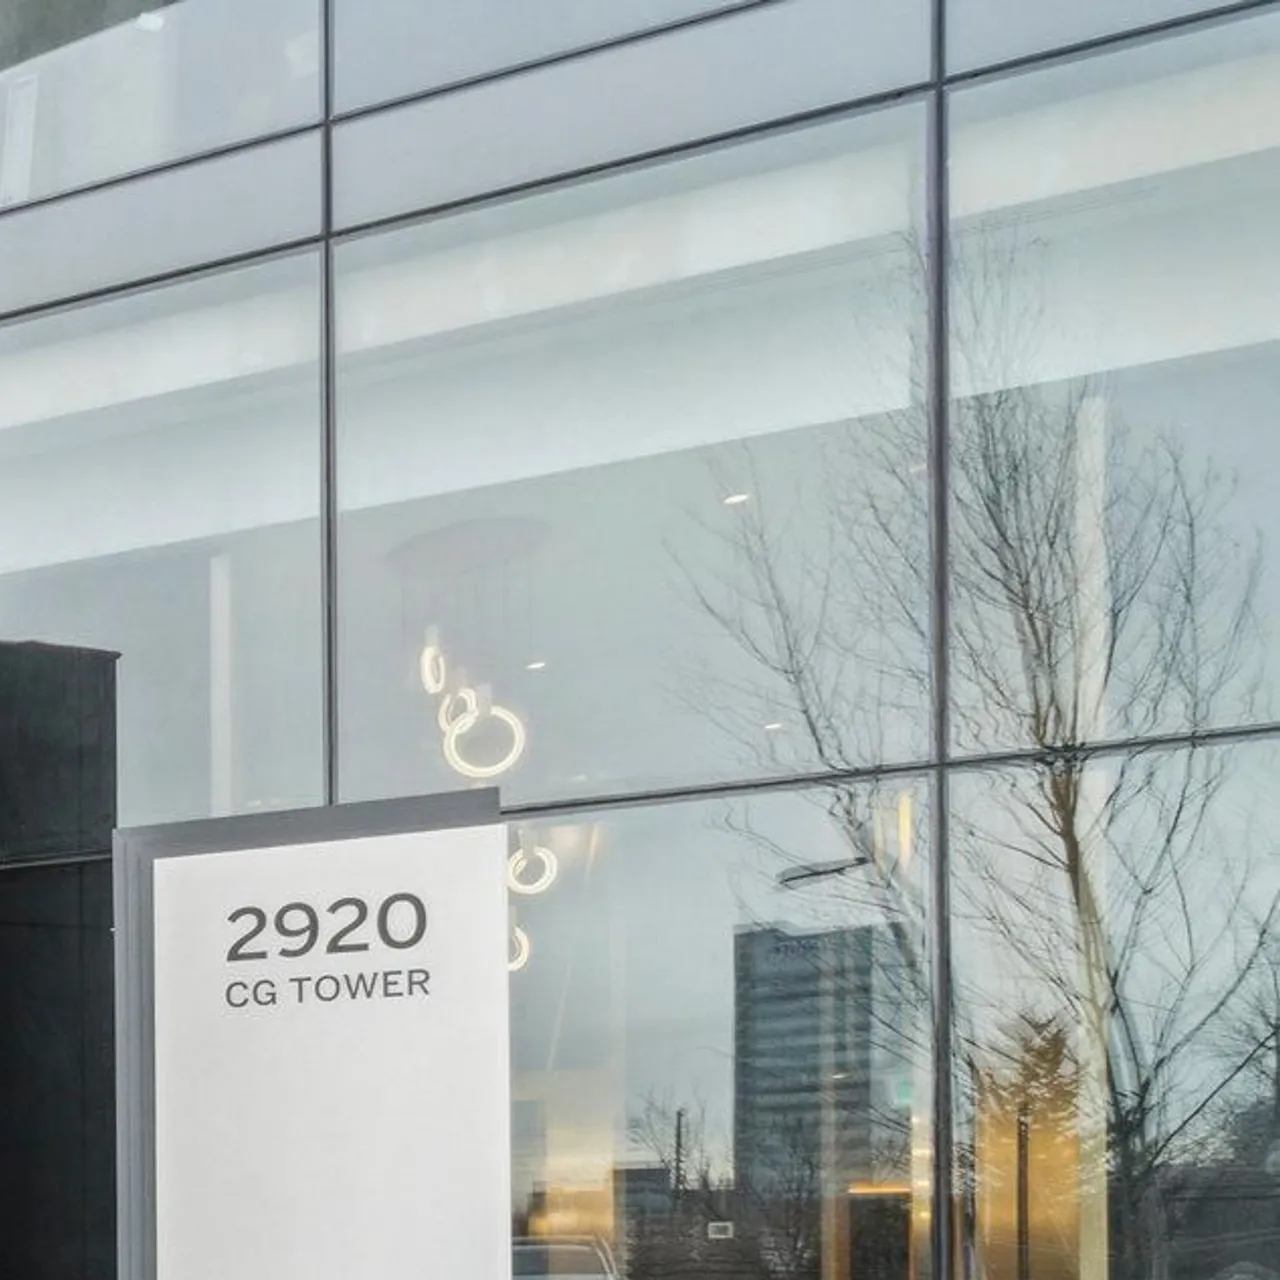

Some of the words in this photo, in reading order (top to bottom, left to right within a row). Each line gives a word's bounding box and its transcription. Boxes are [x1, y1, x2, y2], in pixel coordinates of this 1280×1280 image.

[226, 892, 427, 962] 2920
[225, 979, 278, 1008] CG
[289, 968, 431, 1003] TOWER
